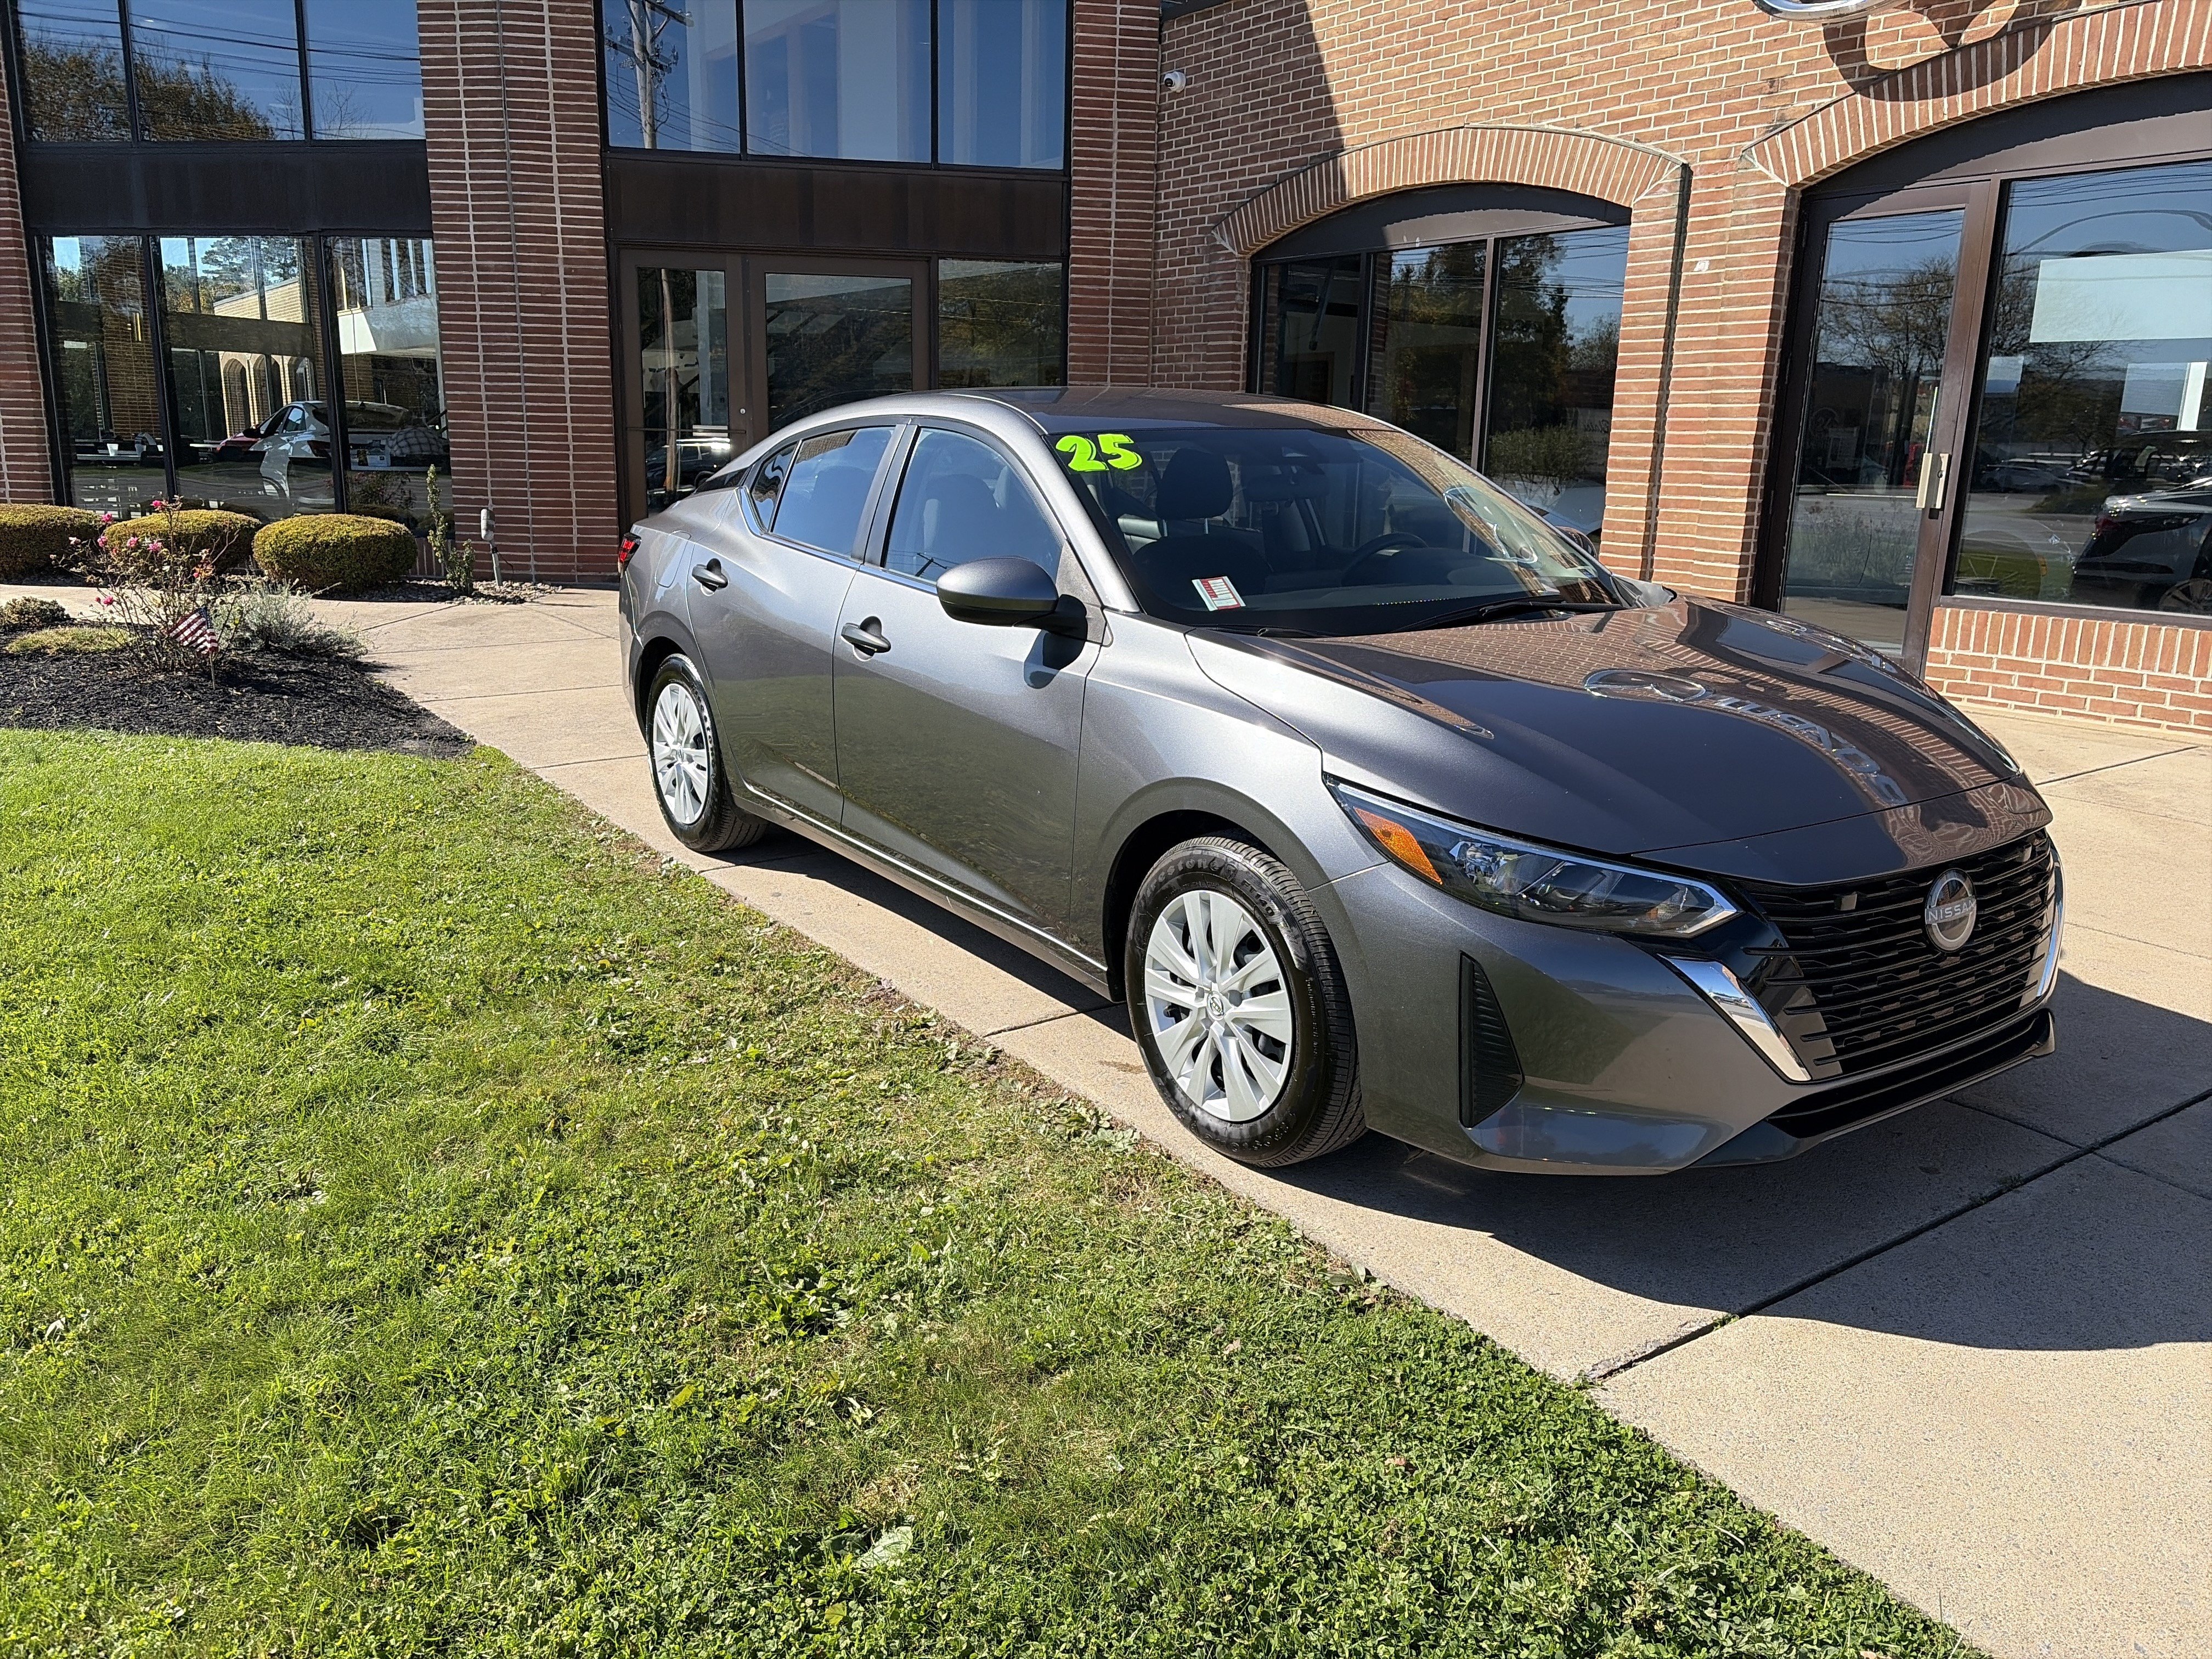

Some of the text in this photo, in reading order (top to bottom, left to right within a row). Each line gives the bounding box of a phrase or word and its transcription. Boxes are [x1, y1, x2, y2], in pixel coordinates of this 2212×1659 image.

[1056, 434, 1143, 472] 25
[1242, 879, 1276, 917] FT140
[1929, 898, 1976, 921] NISSAN
